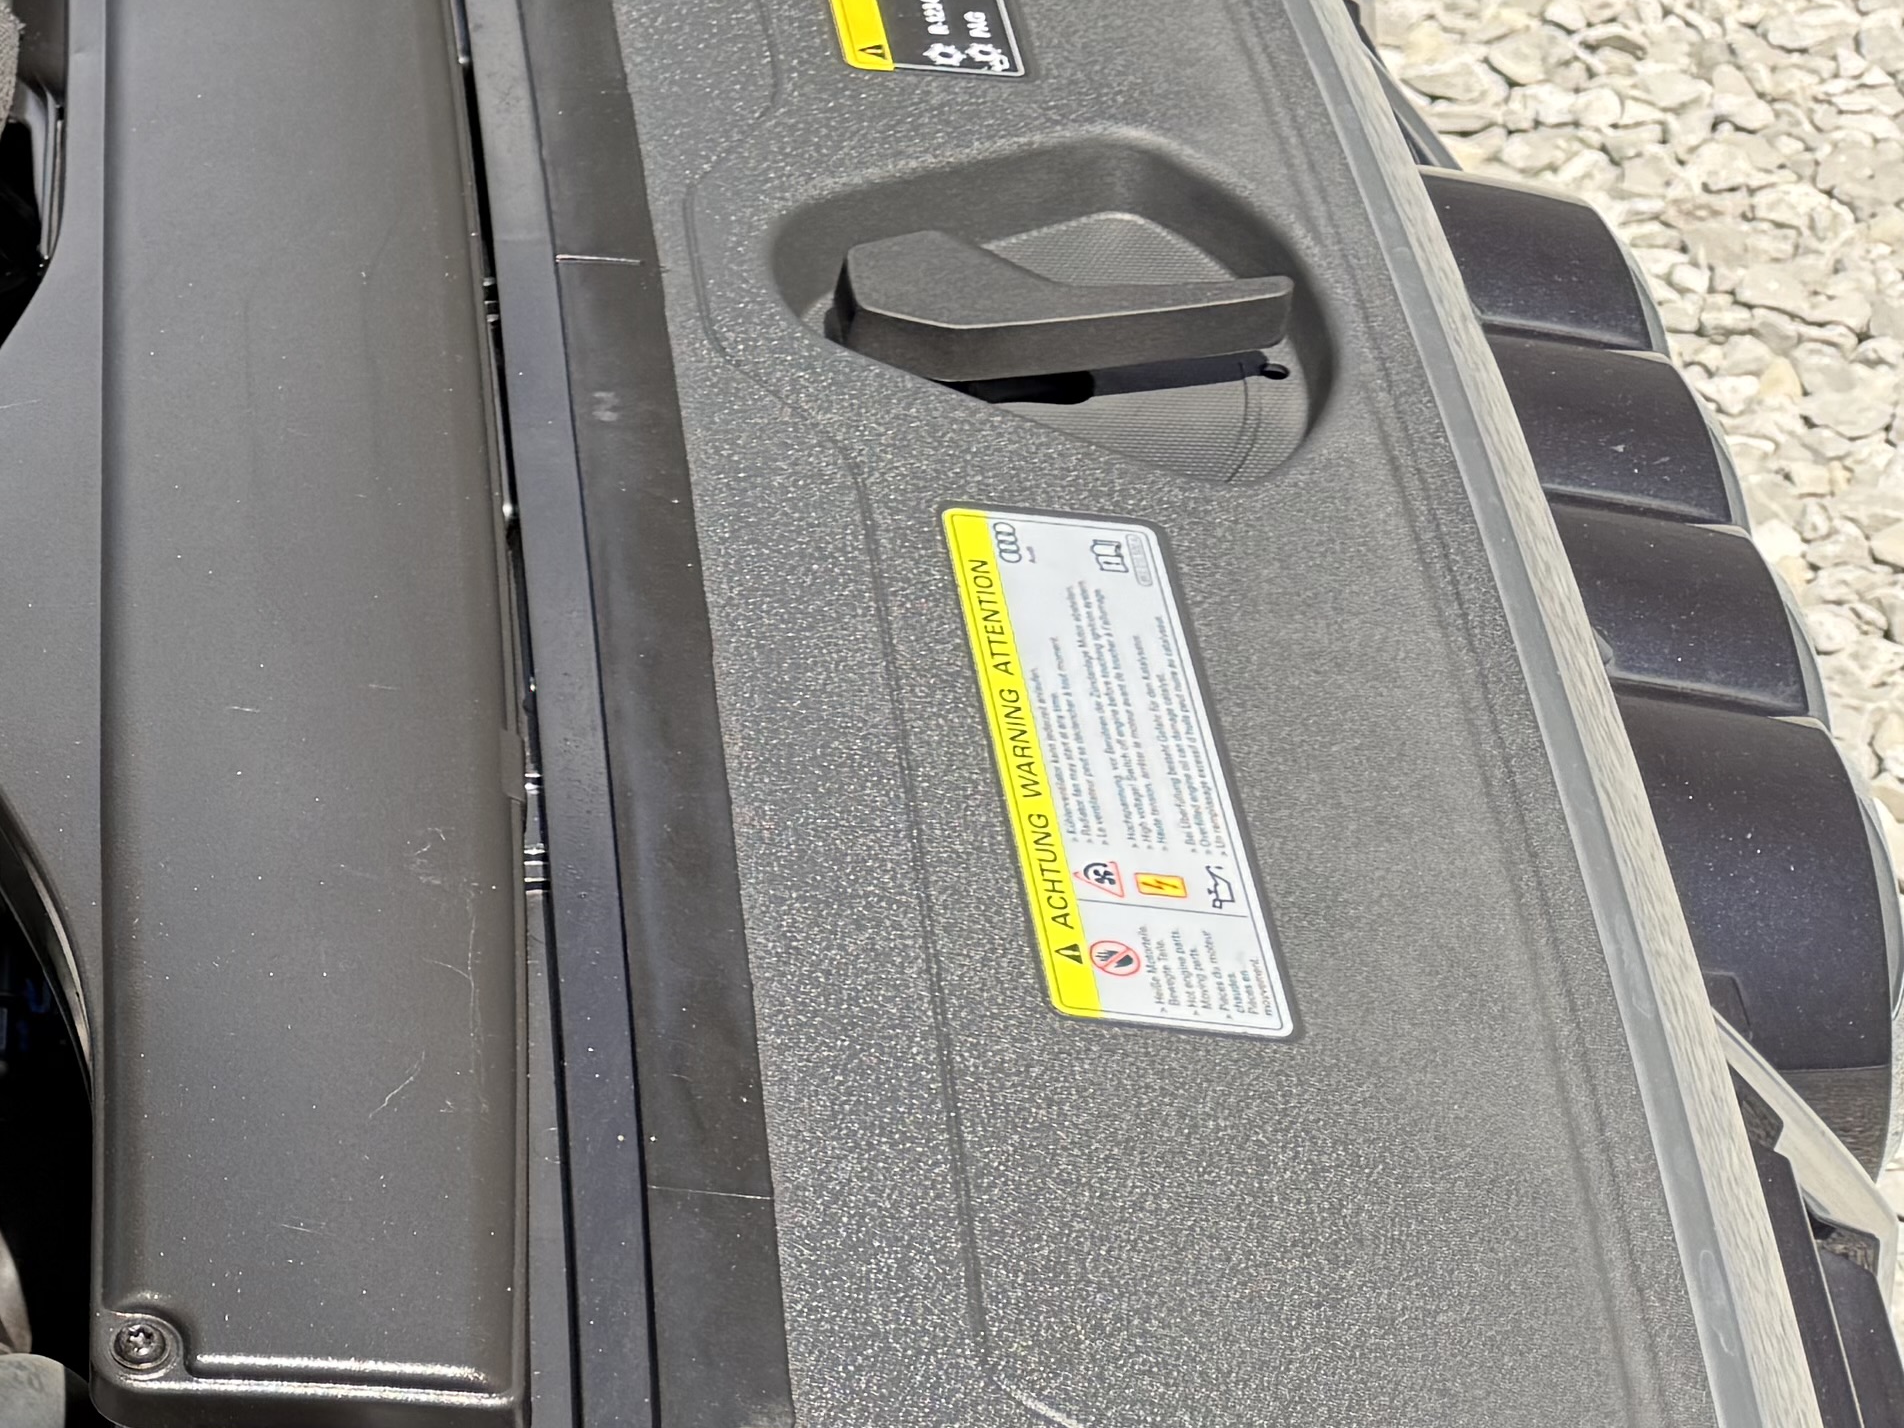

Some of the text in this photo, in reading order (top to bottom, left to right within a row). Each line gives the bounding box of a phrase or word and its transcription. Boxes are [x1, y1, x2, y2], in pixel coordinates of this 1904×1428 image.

[960, 10, 992, 38] PAG
[1101, 680, 1117, 706] before
[1110, 709, 1127, 738] engine
[967, 557, 1074, 929] ACHTUNG WARNING ATTENTION
[1059, 741, 1074, 760] start
[1066, 762, 1080, 781] may
[1069, 782, 1083, 797] fan
[1083, 778, 1104, 824] ventilateur
[1182, 773, 1200, 802] engine
[1073, 799, 1092, 836] Radiator
[1095, 826, 1107, 837] Le
[1138, 821, 1154, 842] High
[1189, 803, 1211, 847] Overfilled
[1201, 929, 1218, 963] moteur
[1176, 956, 1195, 989] engine
[1184, 990, 1199, 1007] Hot
[1193, 973, 1214, 1009] Moving
